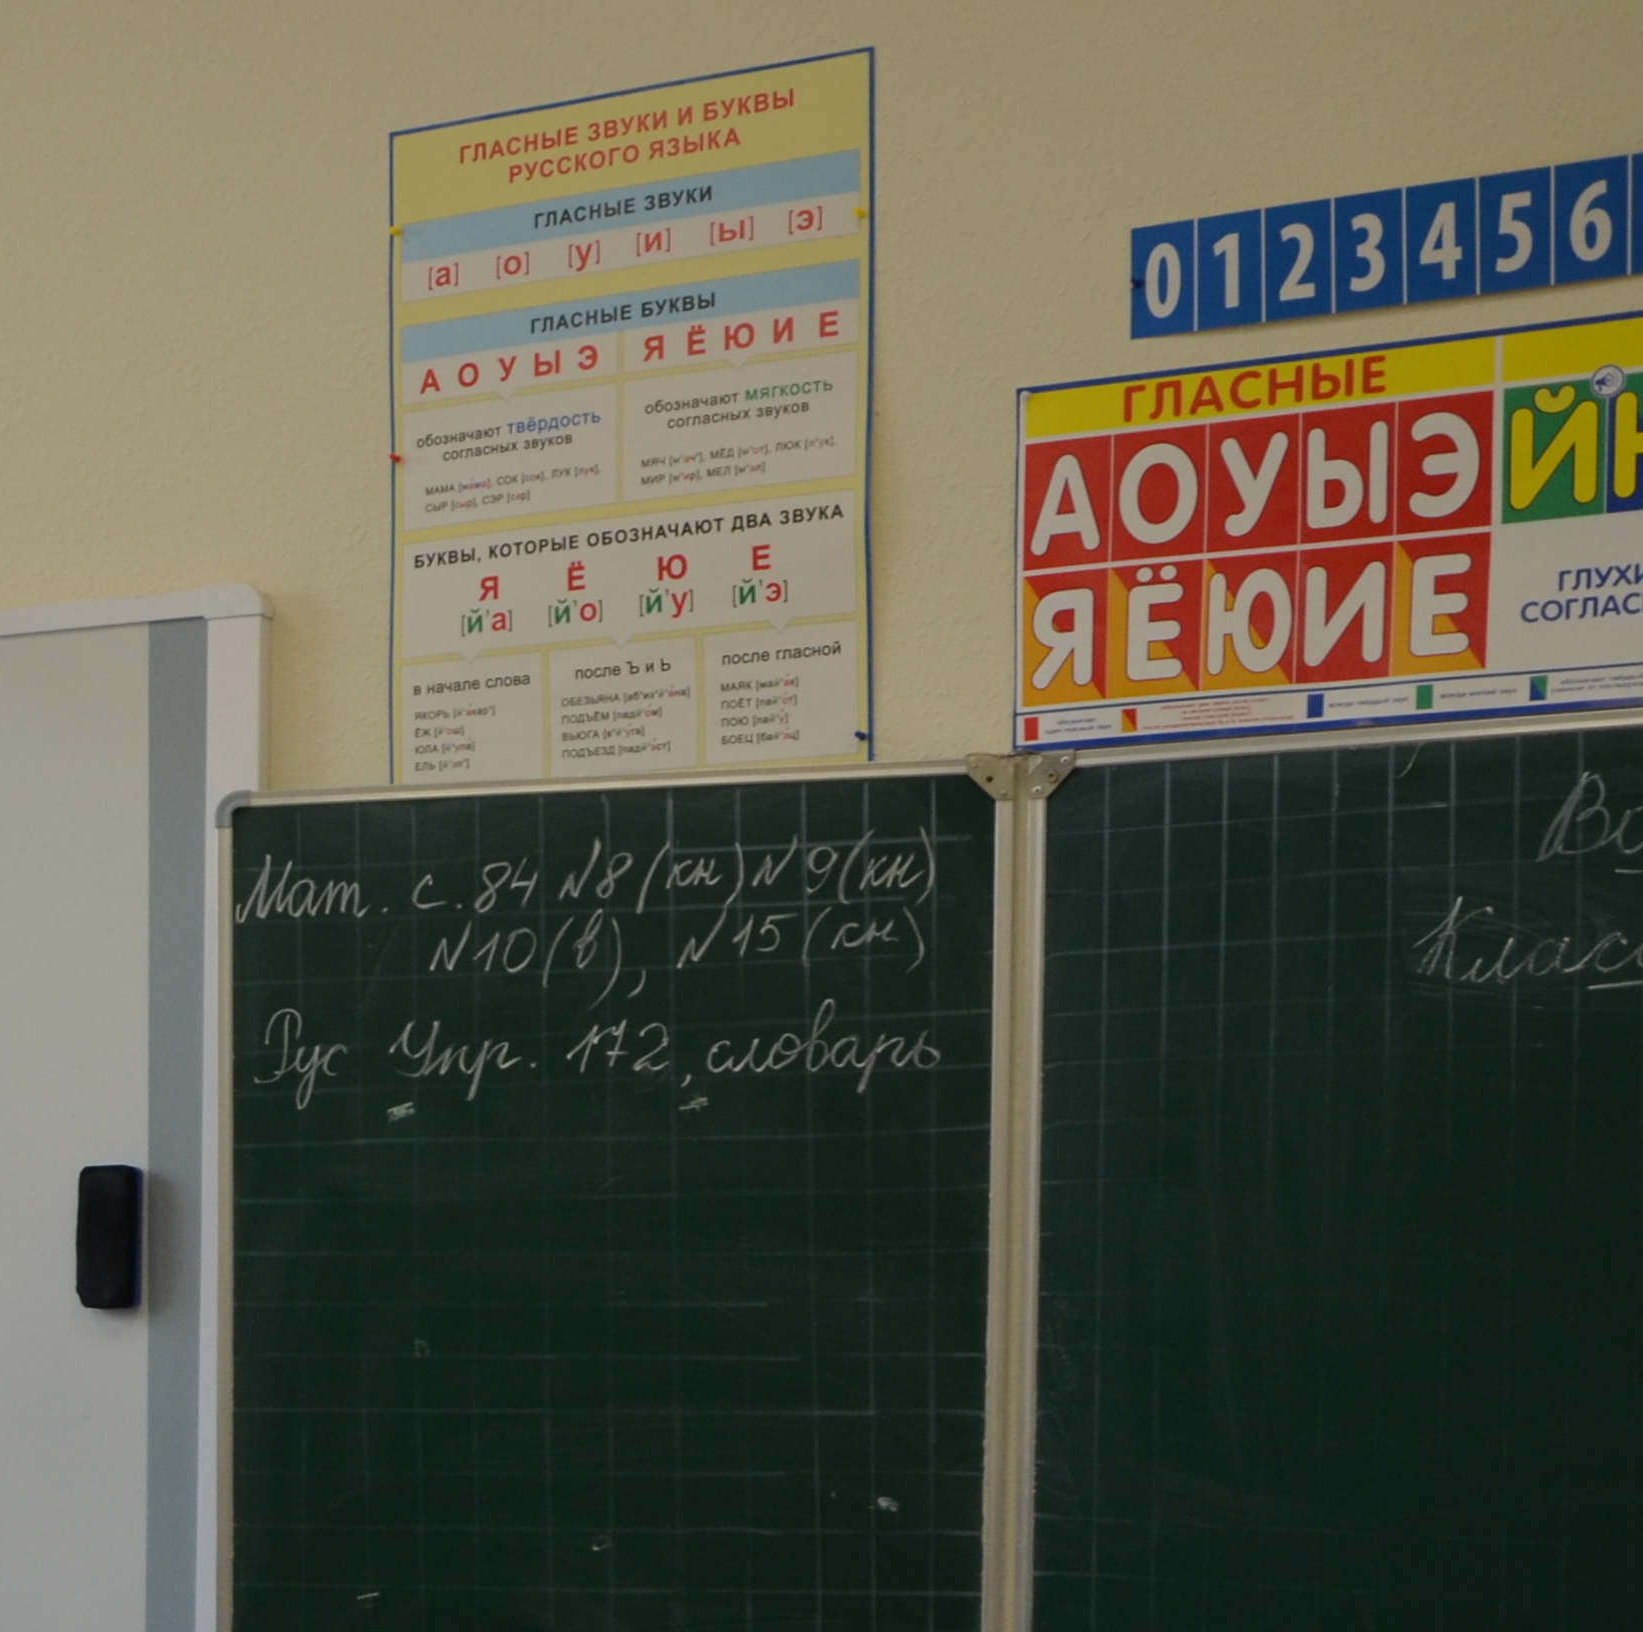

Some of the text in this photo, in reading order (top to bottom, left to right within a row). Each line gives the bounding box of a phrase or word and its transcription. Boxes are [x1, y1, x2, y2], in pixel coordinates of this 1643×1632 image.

[459, 88, 795, 164] ГЛАСНЫЕ ЗВУКИ И БУКВЫ
[509, 127, 742, 183] РУССКОГО ЯЗЫКА
[534, 185, 712, 228] ГЛАСНЫЕ ЗВУКИ
[530, 292, 716, 334] ГЛАСНЫЕ БУКВЫ
[643, 335, 665, 362] Я
[687, 326, 706, 356] Ё
[723, 323, 755, 350] Ю
[772, 316, 795, 344] И
[499, 355, 517, 381] У
[533, 350, 561, 377] Ы
[577, 344, 599, 370] Э
[645, 392, 739, 414] обозначают
[1123, 354, 1387, 424] ГЛАСНЫЕ
[667, 401, 810, 429] согласных звуков
[416, 411, 601, 449] обозначают твёрдость
[442, 434, 573, 462] согласных звуков
[710, 447, 735, 459] МЁД
[775, 439, 801, 451] ЛЮК
[550, 467, 572, 478] ЛУК
[641, 457, 666, 467] МЯЧ
[707, 465, 731, 477] МЕЛ
[425, 484, 456, 496] МАМА
[497, 475, 518, 486] СОК
[641, 473, 666, 485] МИР
[425, 502, 448, 512] СЫР
[482, 494, 504, 505] СЭР
[413, 504, 844, 568] БУКВЫ, КОТОРЫЕ ОБОЗНАЧАЮТ ДВА ЗВУКА
[479, 544, 772, 602] Я Ё Ю Е
[1520, 592, 1643, 623] СОГЛАС
[721, 641, 842, 666] после гласной
[575, 657, 672, 680] после Ъ и Ь
[413, 674, 531, 695] в начале слова
[475, 858, 538, 914] 84
[253, 1008, 349, 1110] Рус
[706, 998, 942, 1093] словарь
